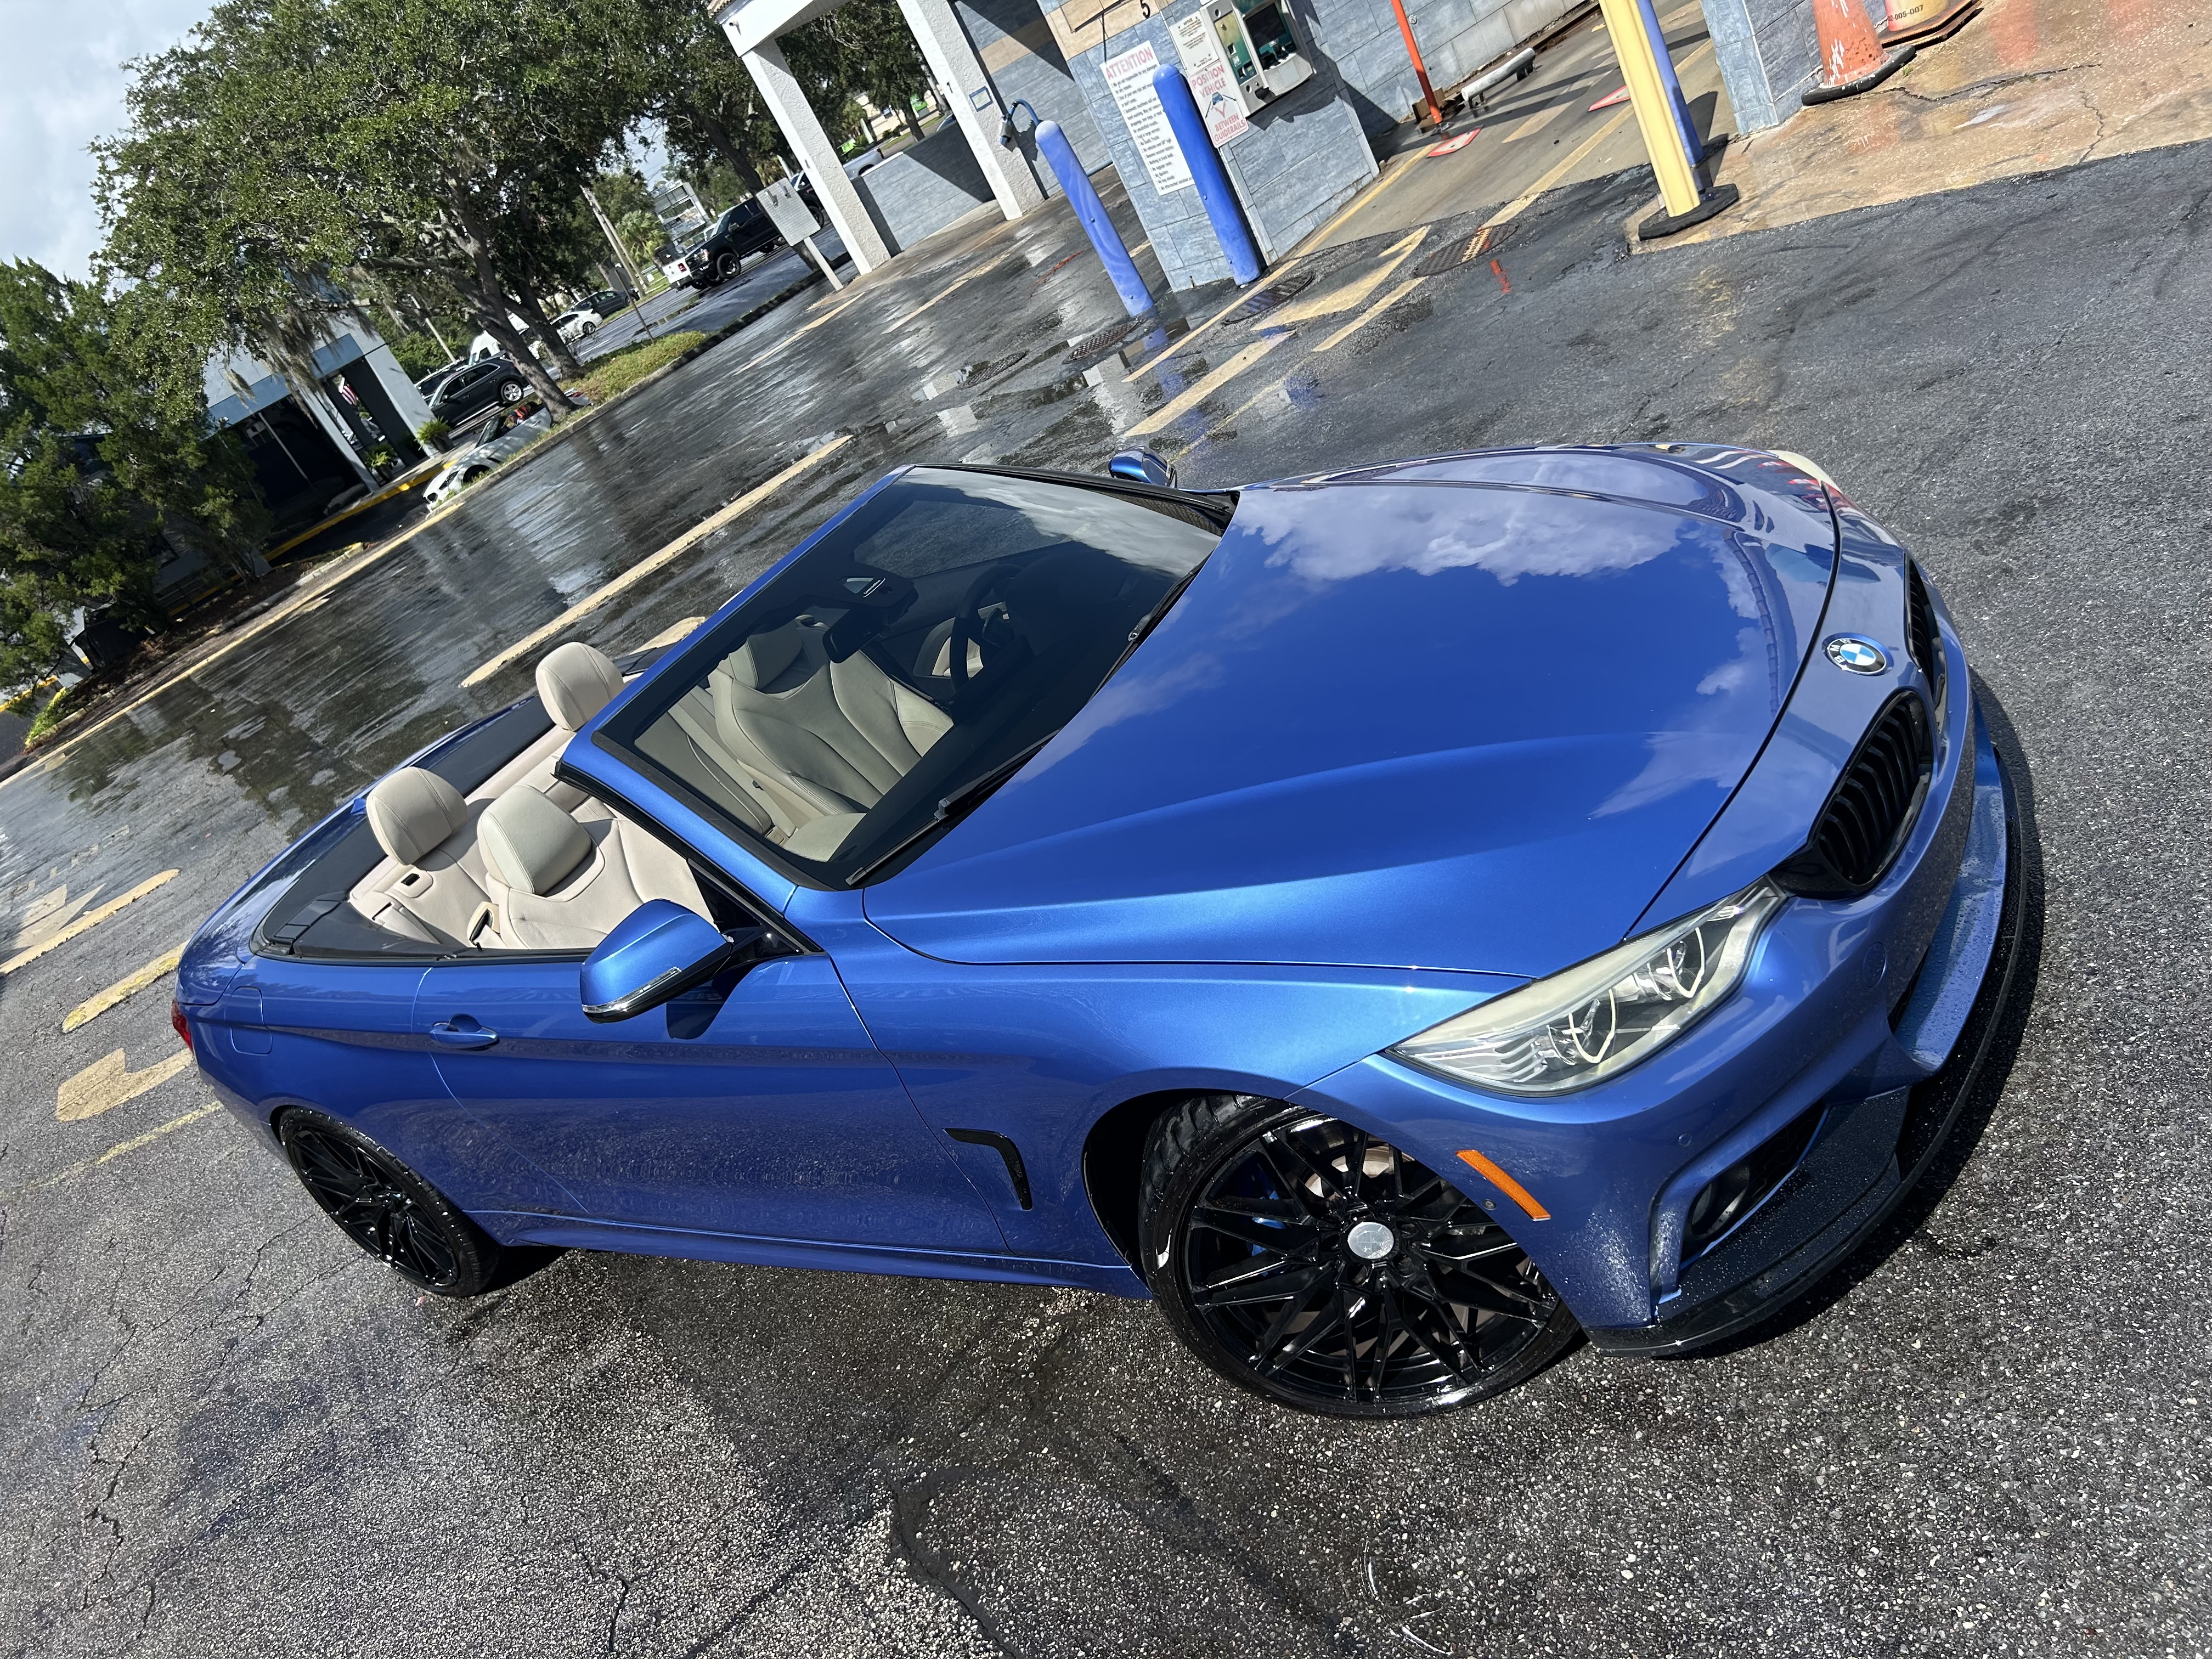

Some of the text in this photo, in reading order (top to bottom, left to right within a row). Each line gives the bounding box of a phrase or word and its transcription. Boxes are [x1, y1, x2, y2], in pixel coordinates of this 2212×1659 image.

[1140, 0, 1150, 19] 5
[1105, 47, 1154, 80] ATTENTION
[1191, 65, 1225, 89] POSITION
[1199, 77, 1227, 98] VEHICLE
[1214, 119, 1245, 142] GUIDERAILS
[1215, 112, 1239, 132] BETWEEN
[1830, 638, 1852, 663] BMW
